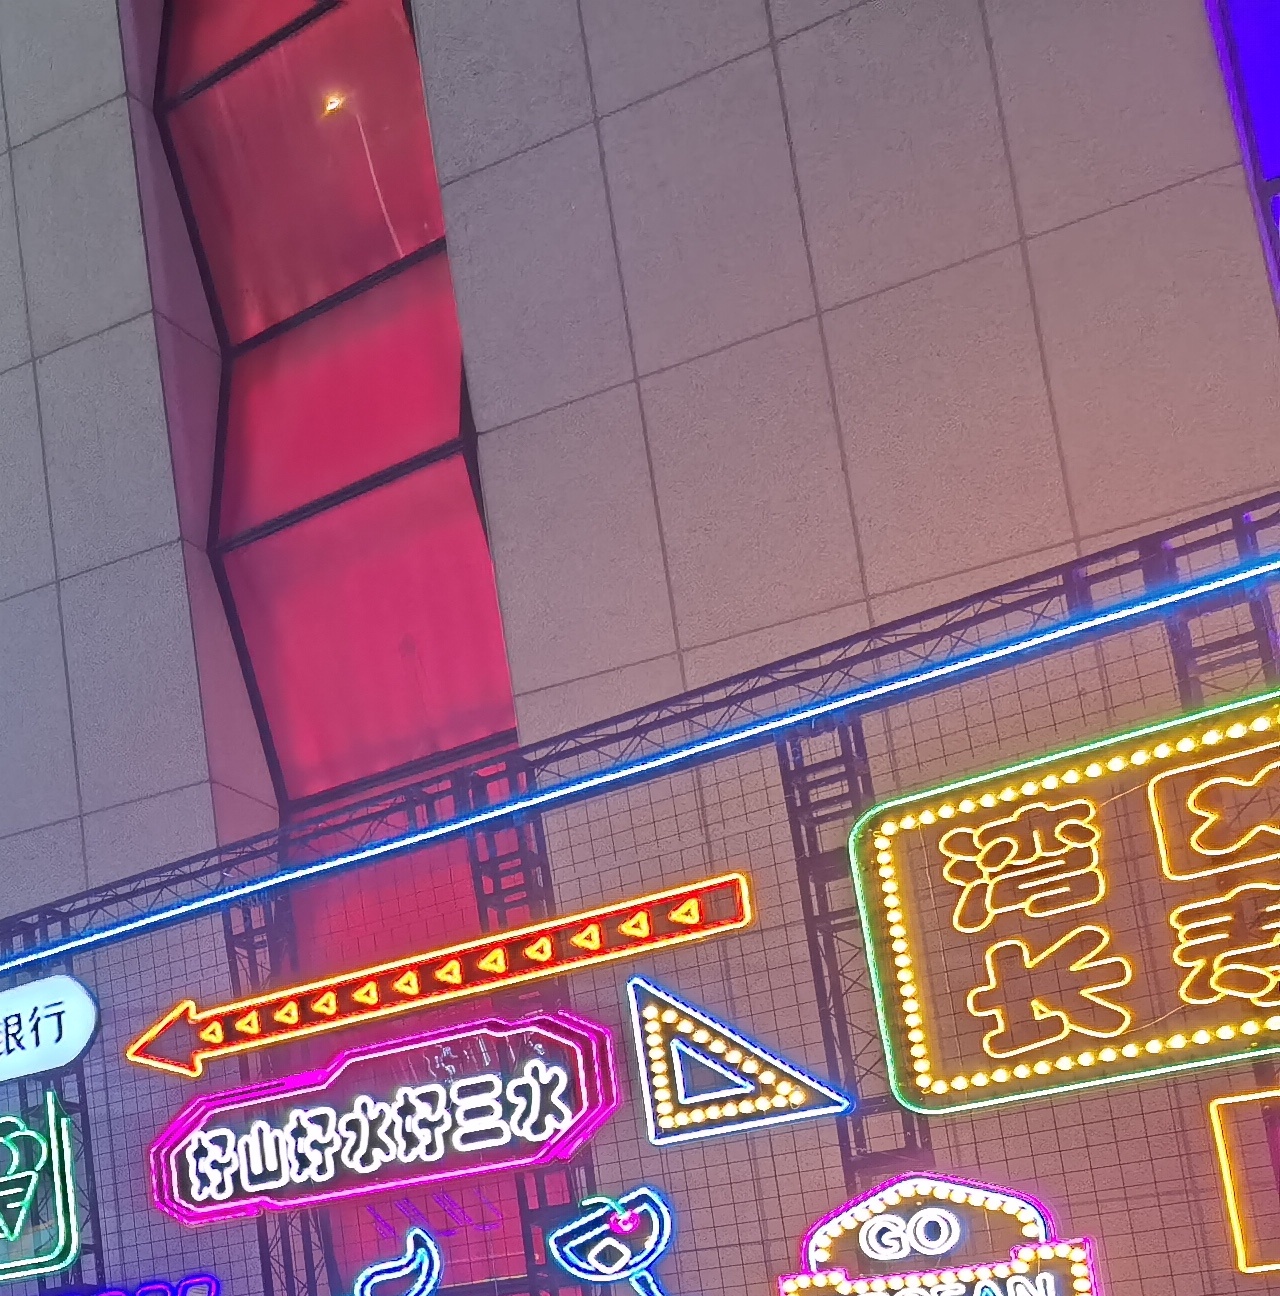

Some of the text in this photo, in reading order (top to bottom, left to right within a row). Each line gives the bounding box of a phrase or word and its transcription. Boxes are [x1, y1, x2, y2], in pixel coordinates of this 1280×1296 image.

[185, 1057, 574, 1202] 好山好水好三水
[859, 1207, 960, 1260] GO
